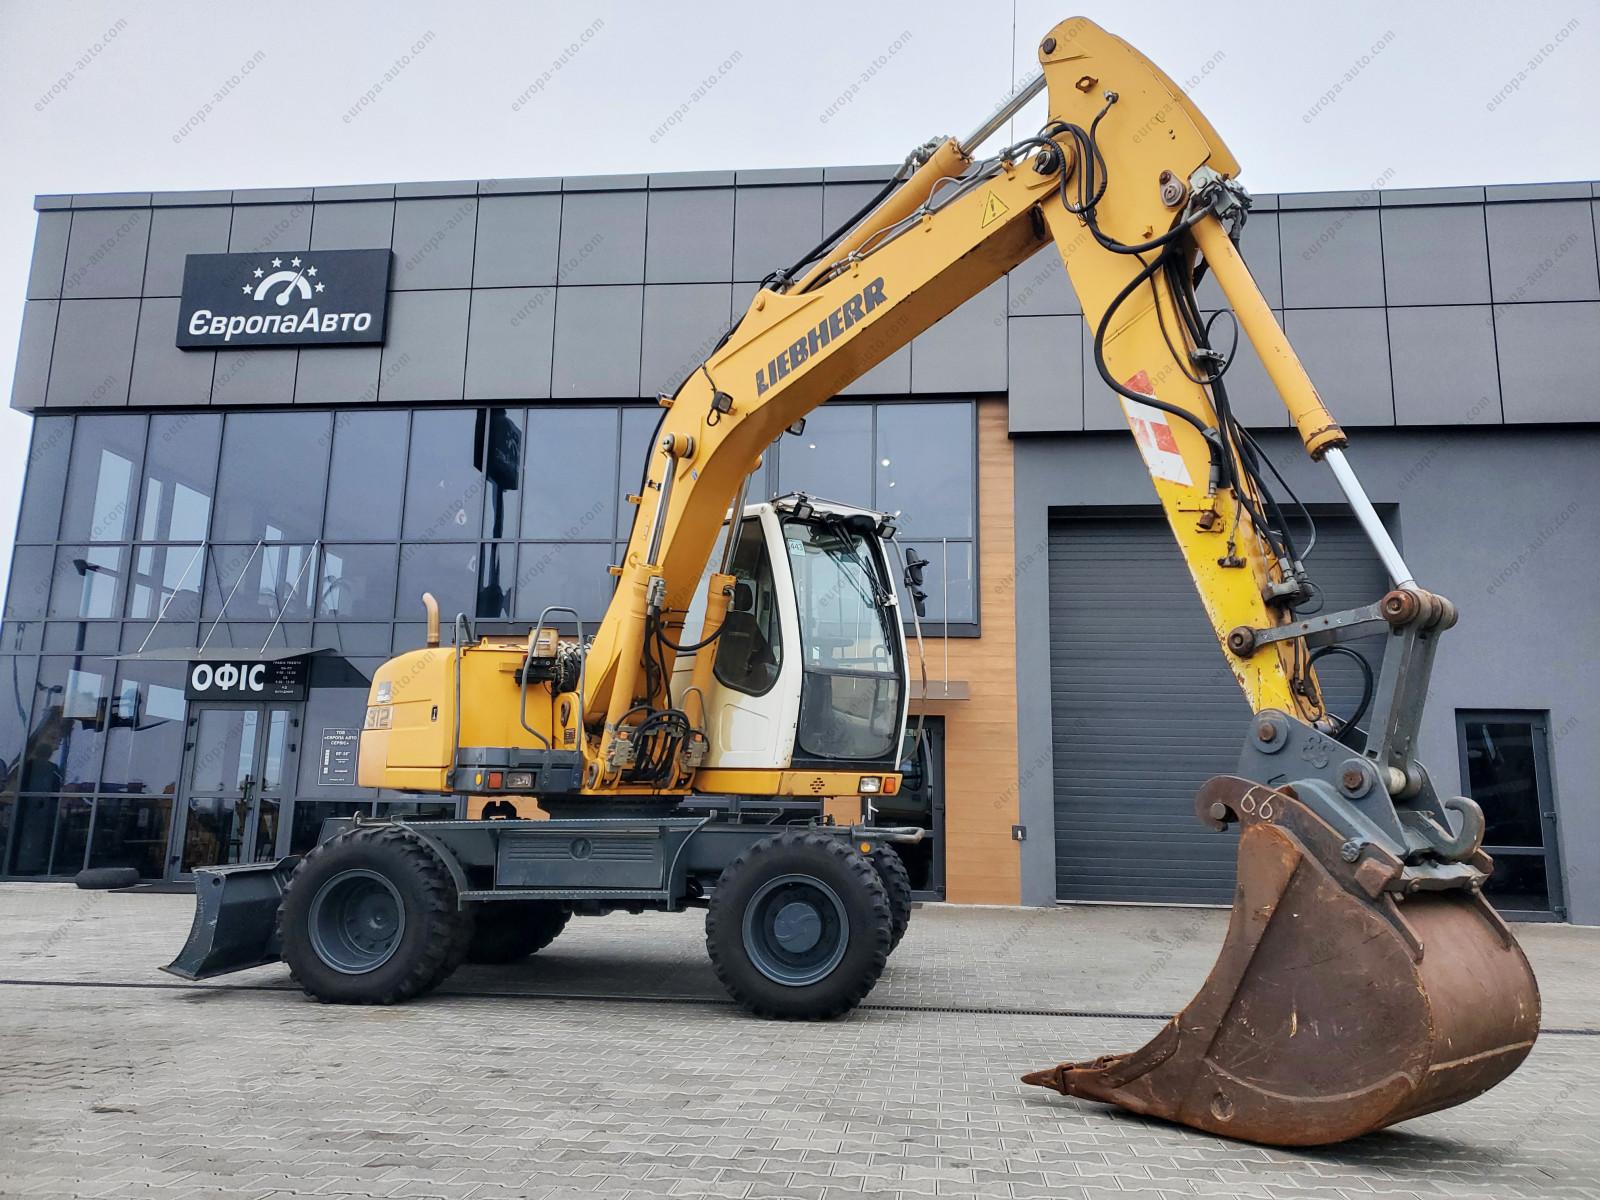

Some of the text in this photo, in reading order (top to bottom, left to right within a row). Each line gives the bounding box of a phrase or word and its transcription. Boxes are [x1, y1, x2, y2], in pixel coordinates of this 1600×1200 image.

[188, 307, 372, 342] ЄвропаАвто
[756, 276, 888, 398] LIEBHERR
[191, 663, 266, 692] ОФІС
